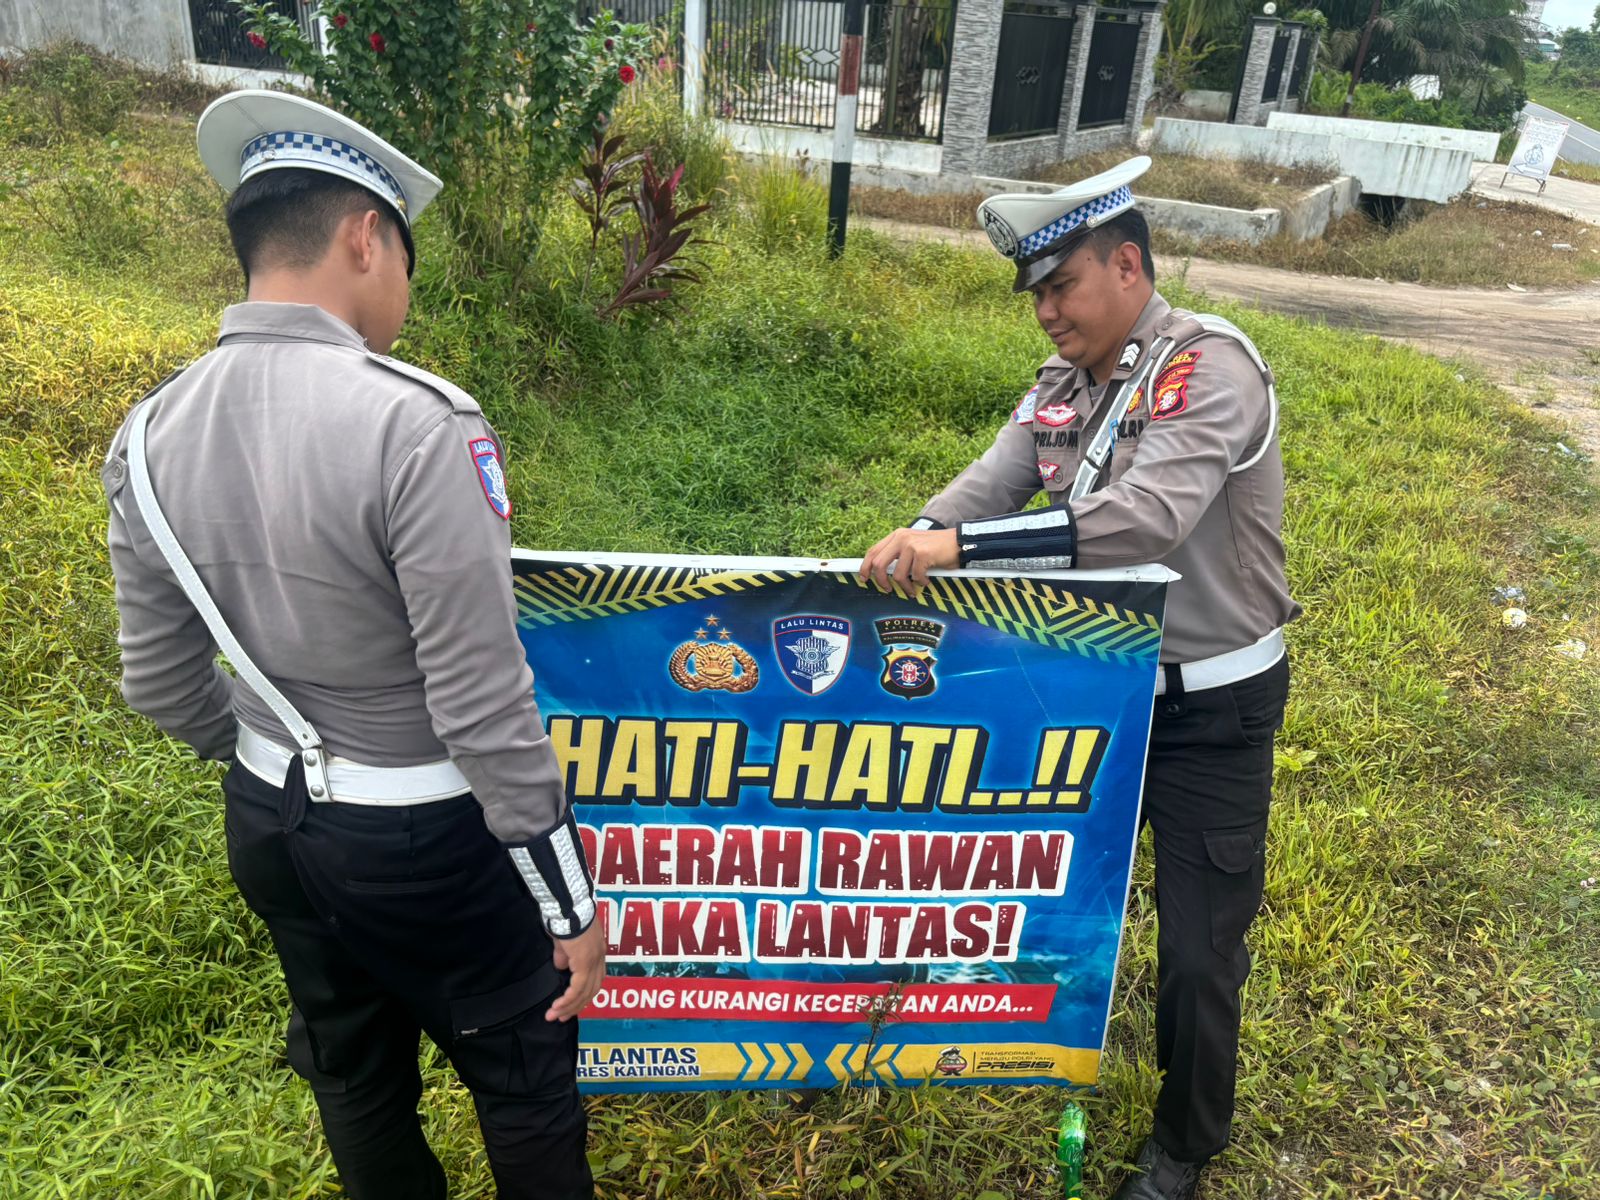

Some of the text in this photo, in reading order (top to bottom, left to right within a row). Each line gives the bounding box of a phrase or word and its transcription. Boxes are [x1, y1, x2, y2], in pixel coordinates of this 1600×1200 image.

[780, 618, 844, 630] LALU LINTAS
[884, 619, 935, 629] POLRES
[818, 829, 1066, 891] RAWAN
[756, 901, 1019, 959] LANTAS!
[592, 988, 676, 1009] OLONG
[679, 989, 789, 1012] KURANGI
[940, 994, 1034, 1014] ANDA...
[577, 1046, 697, 1065] TLANTAS
[577, 1065, 700, 1078] RES KATINGAN
[975, 1061, 1055, 1070] PRESISI
